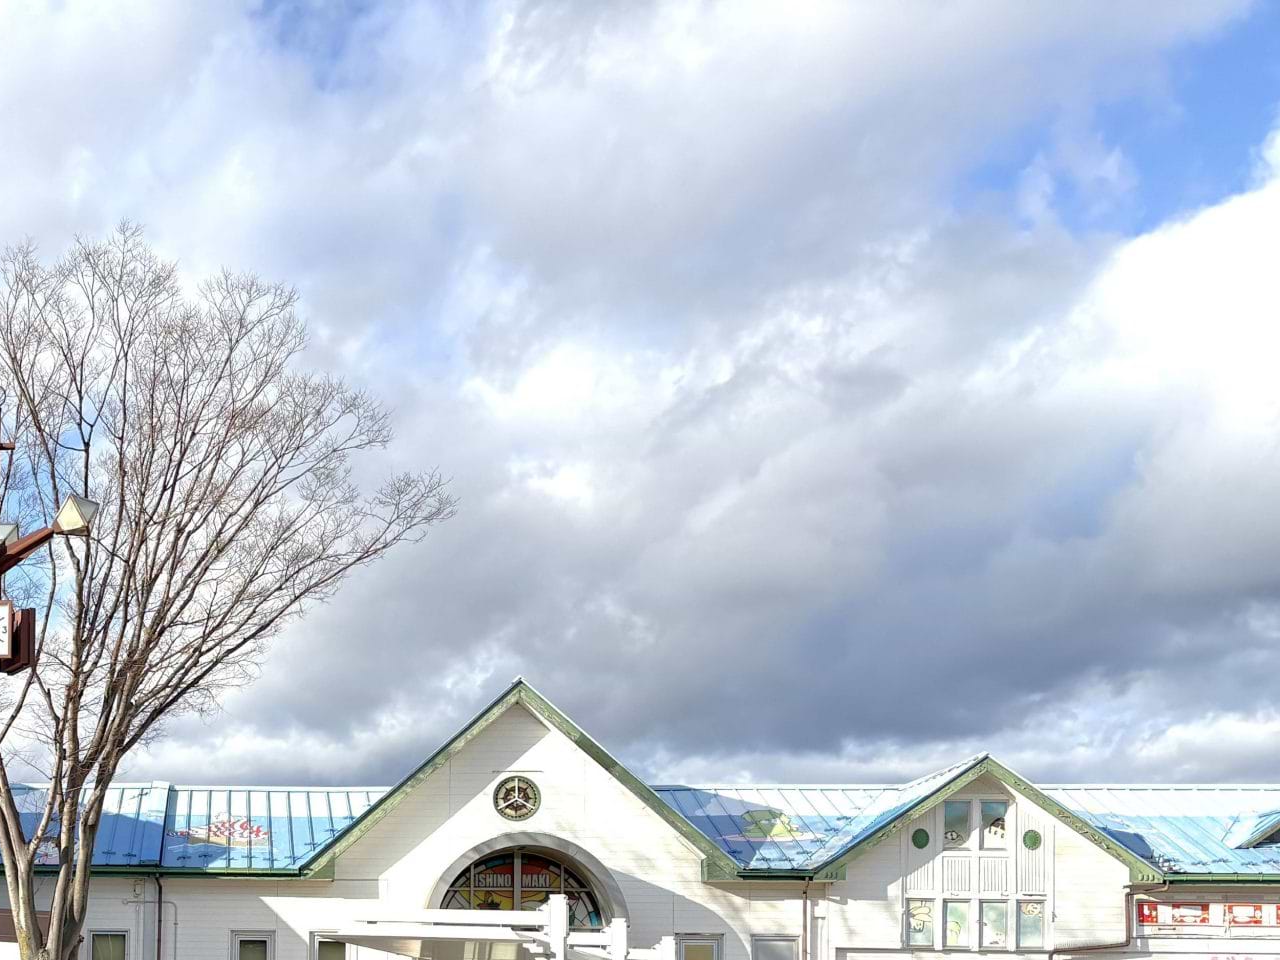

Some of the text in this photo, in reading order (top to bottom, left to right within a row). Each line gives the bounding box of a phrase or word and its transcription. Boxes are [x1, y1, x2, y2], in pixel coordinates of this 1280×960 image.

[1, 626, 8, 634] 3
[475, 873, 549, 887] ISHINO MAKI
